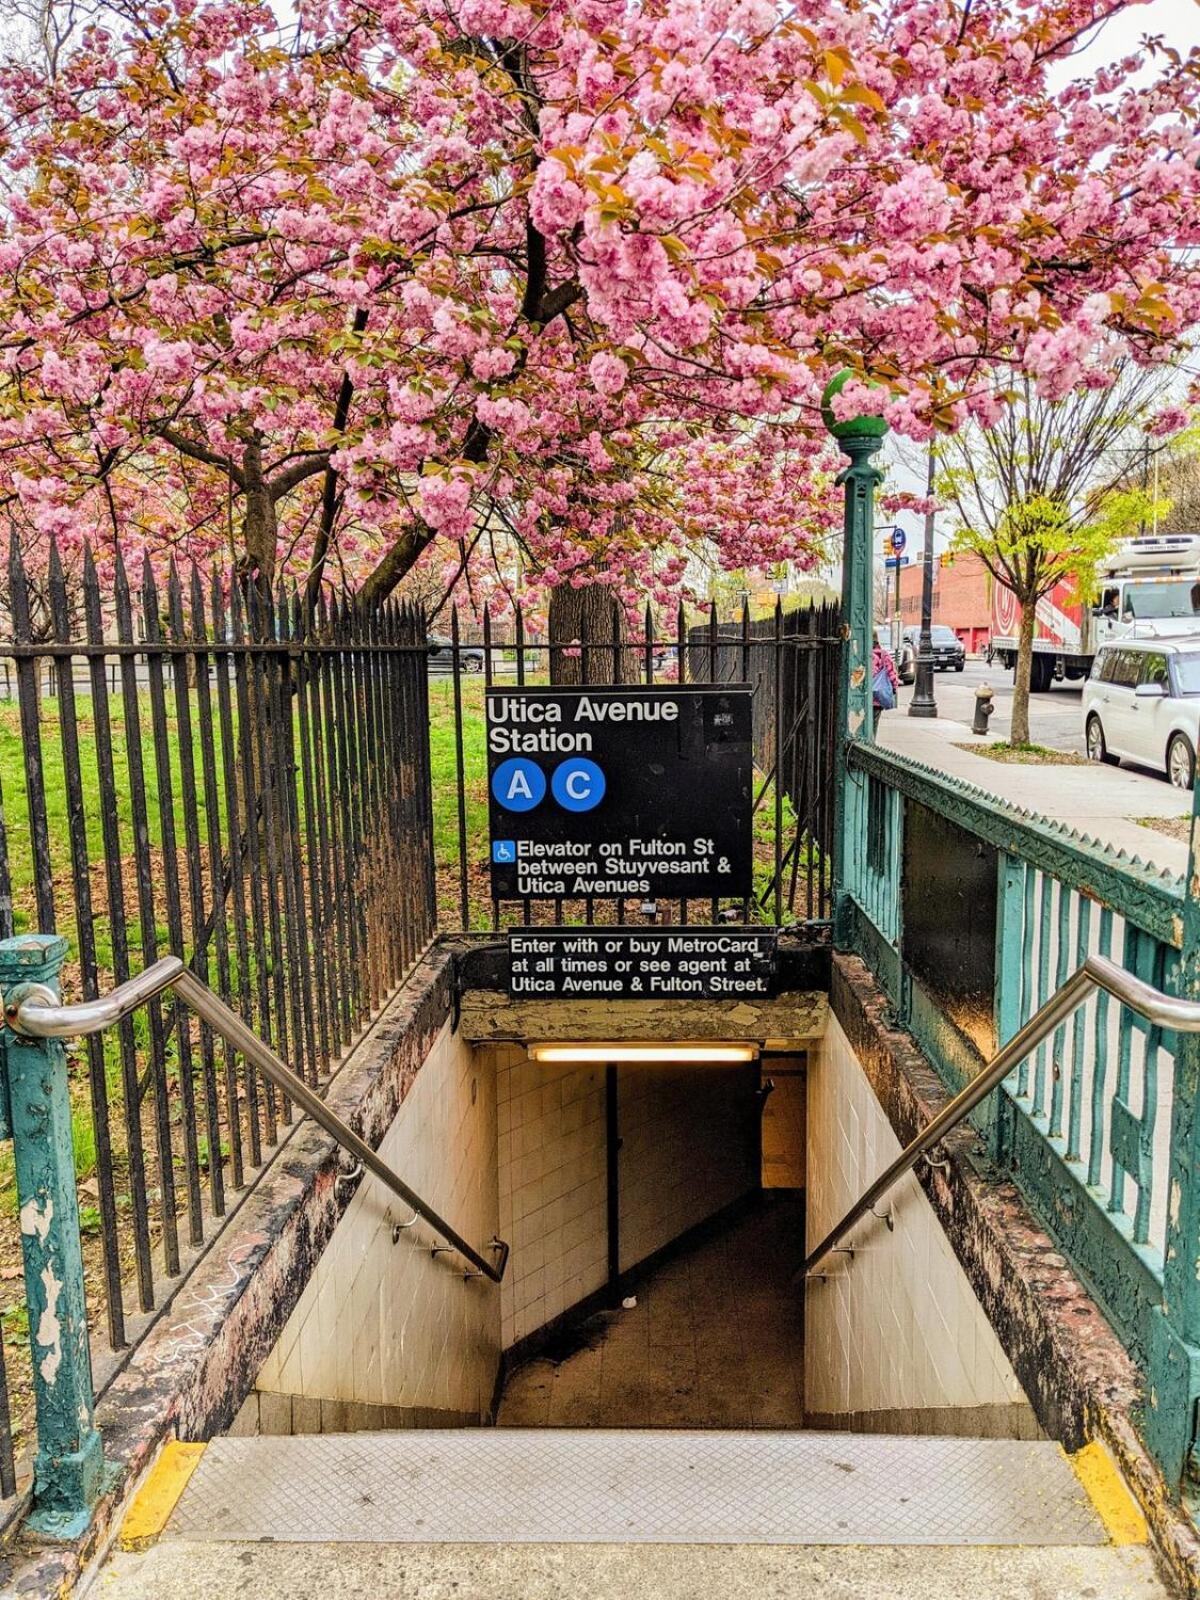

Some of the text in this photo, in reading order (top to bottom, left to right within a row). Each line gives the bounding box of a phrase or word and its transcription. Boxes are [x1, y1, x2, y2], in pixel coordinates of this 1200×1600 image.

[489, 697, 678, 723] Utica Avenue
[490, 727, 592, 752] Station
[507, 770, 590, 799] A C
[518, 838, 714, 856] Elevator on Fulton St
[518, 857, 730, 877] between Stuyvesant &
[519, 876, 649, 893] Utica Avenues
[511, 938, 759, 955] Enter with or buy MetroCard
[512, 958, 750, 975] at all times or see agent at
[512, 977, 766, 991] Utica Avenue & Fulton Street.
